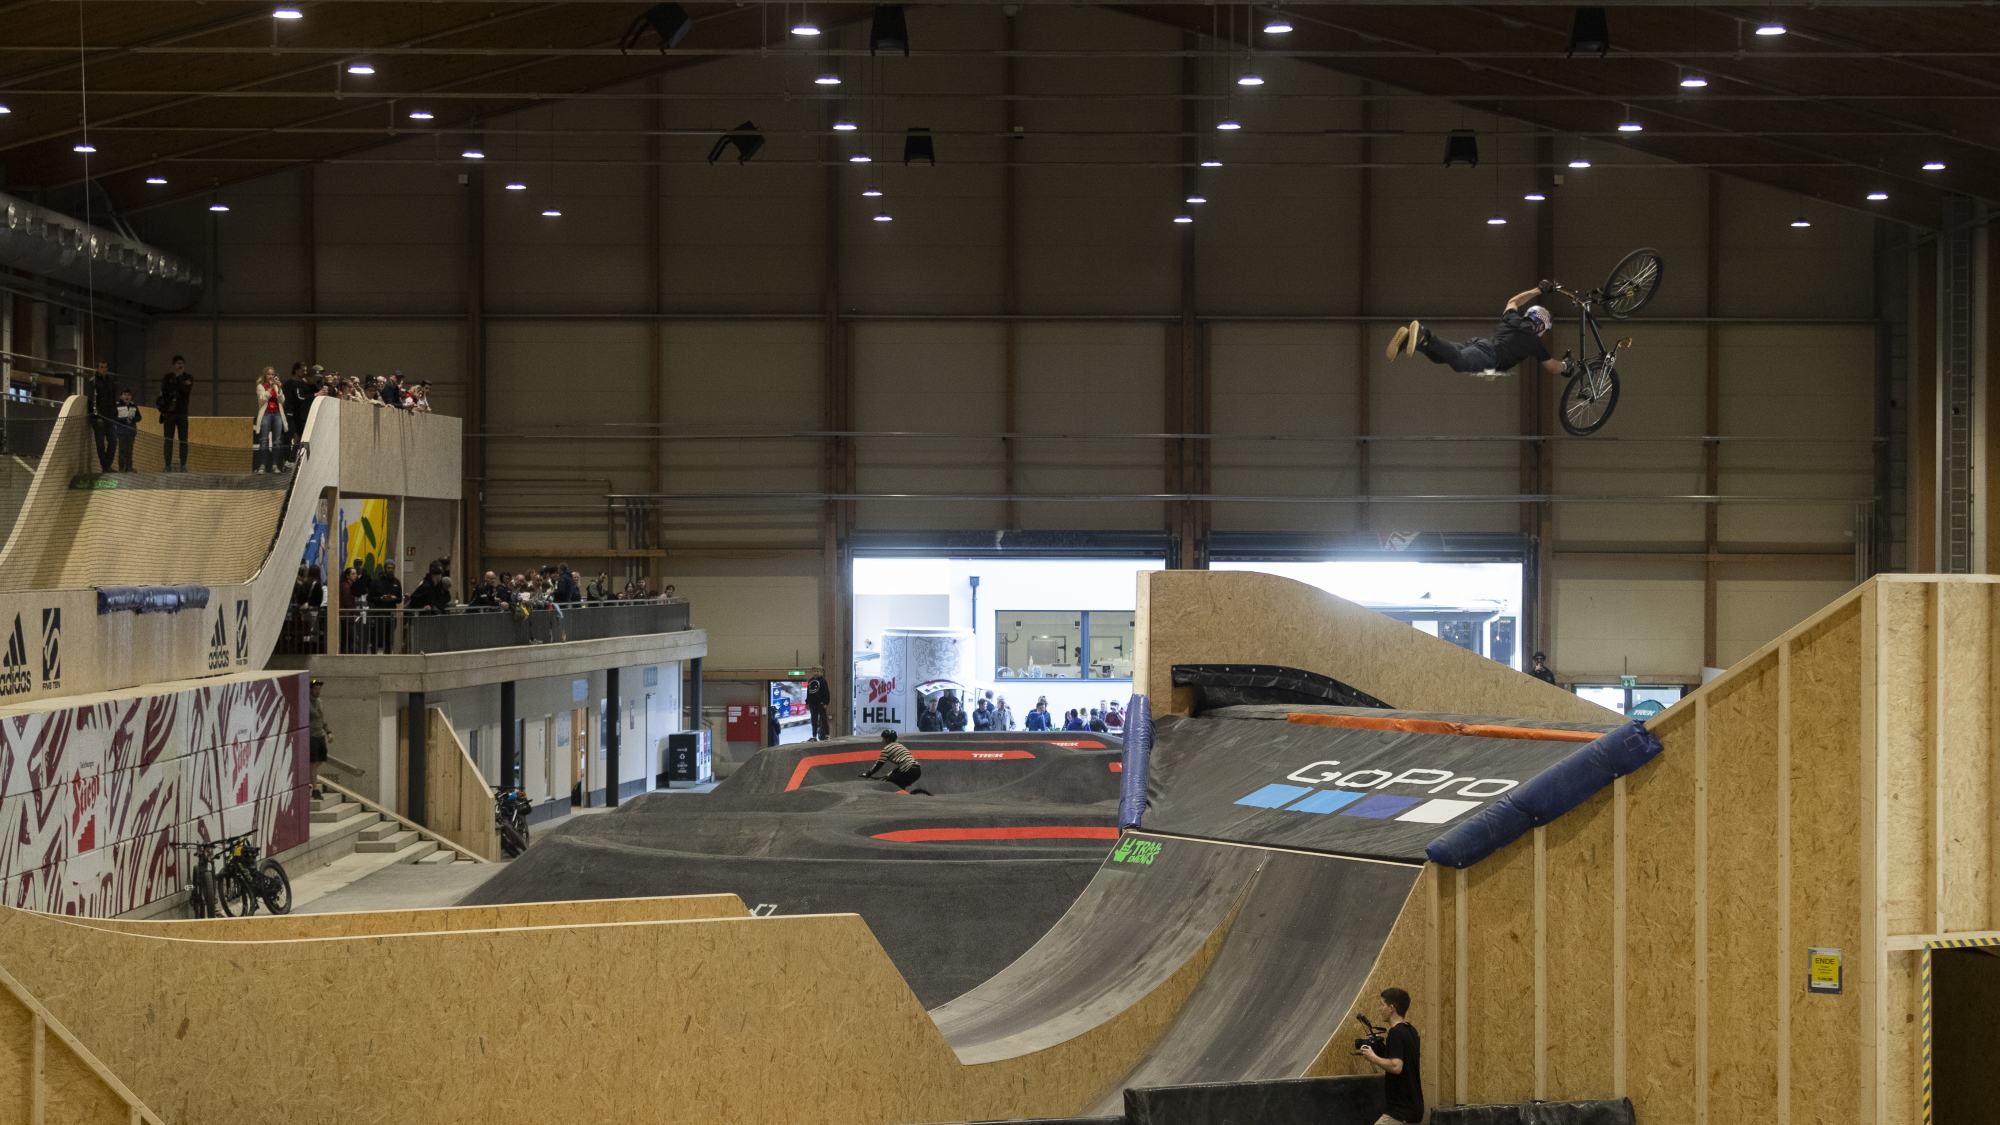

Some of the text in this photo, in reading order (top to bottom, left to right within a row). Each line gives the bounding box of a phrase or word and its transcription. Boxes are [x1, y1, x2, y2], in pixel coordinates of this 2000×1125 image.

[0, 666, 31, 696] adidas
[869, 677, 895, 703] Stiegl
[863, 706, 901, 724] HELL
[1633, 709, 1656, 717] TREK
[1815, 957, 1836, 965] ENDE
